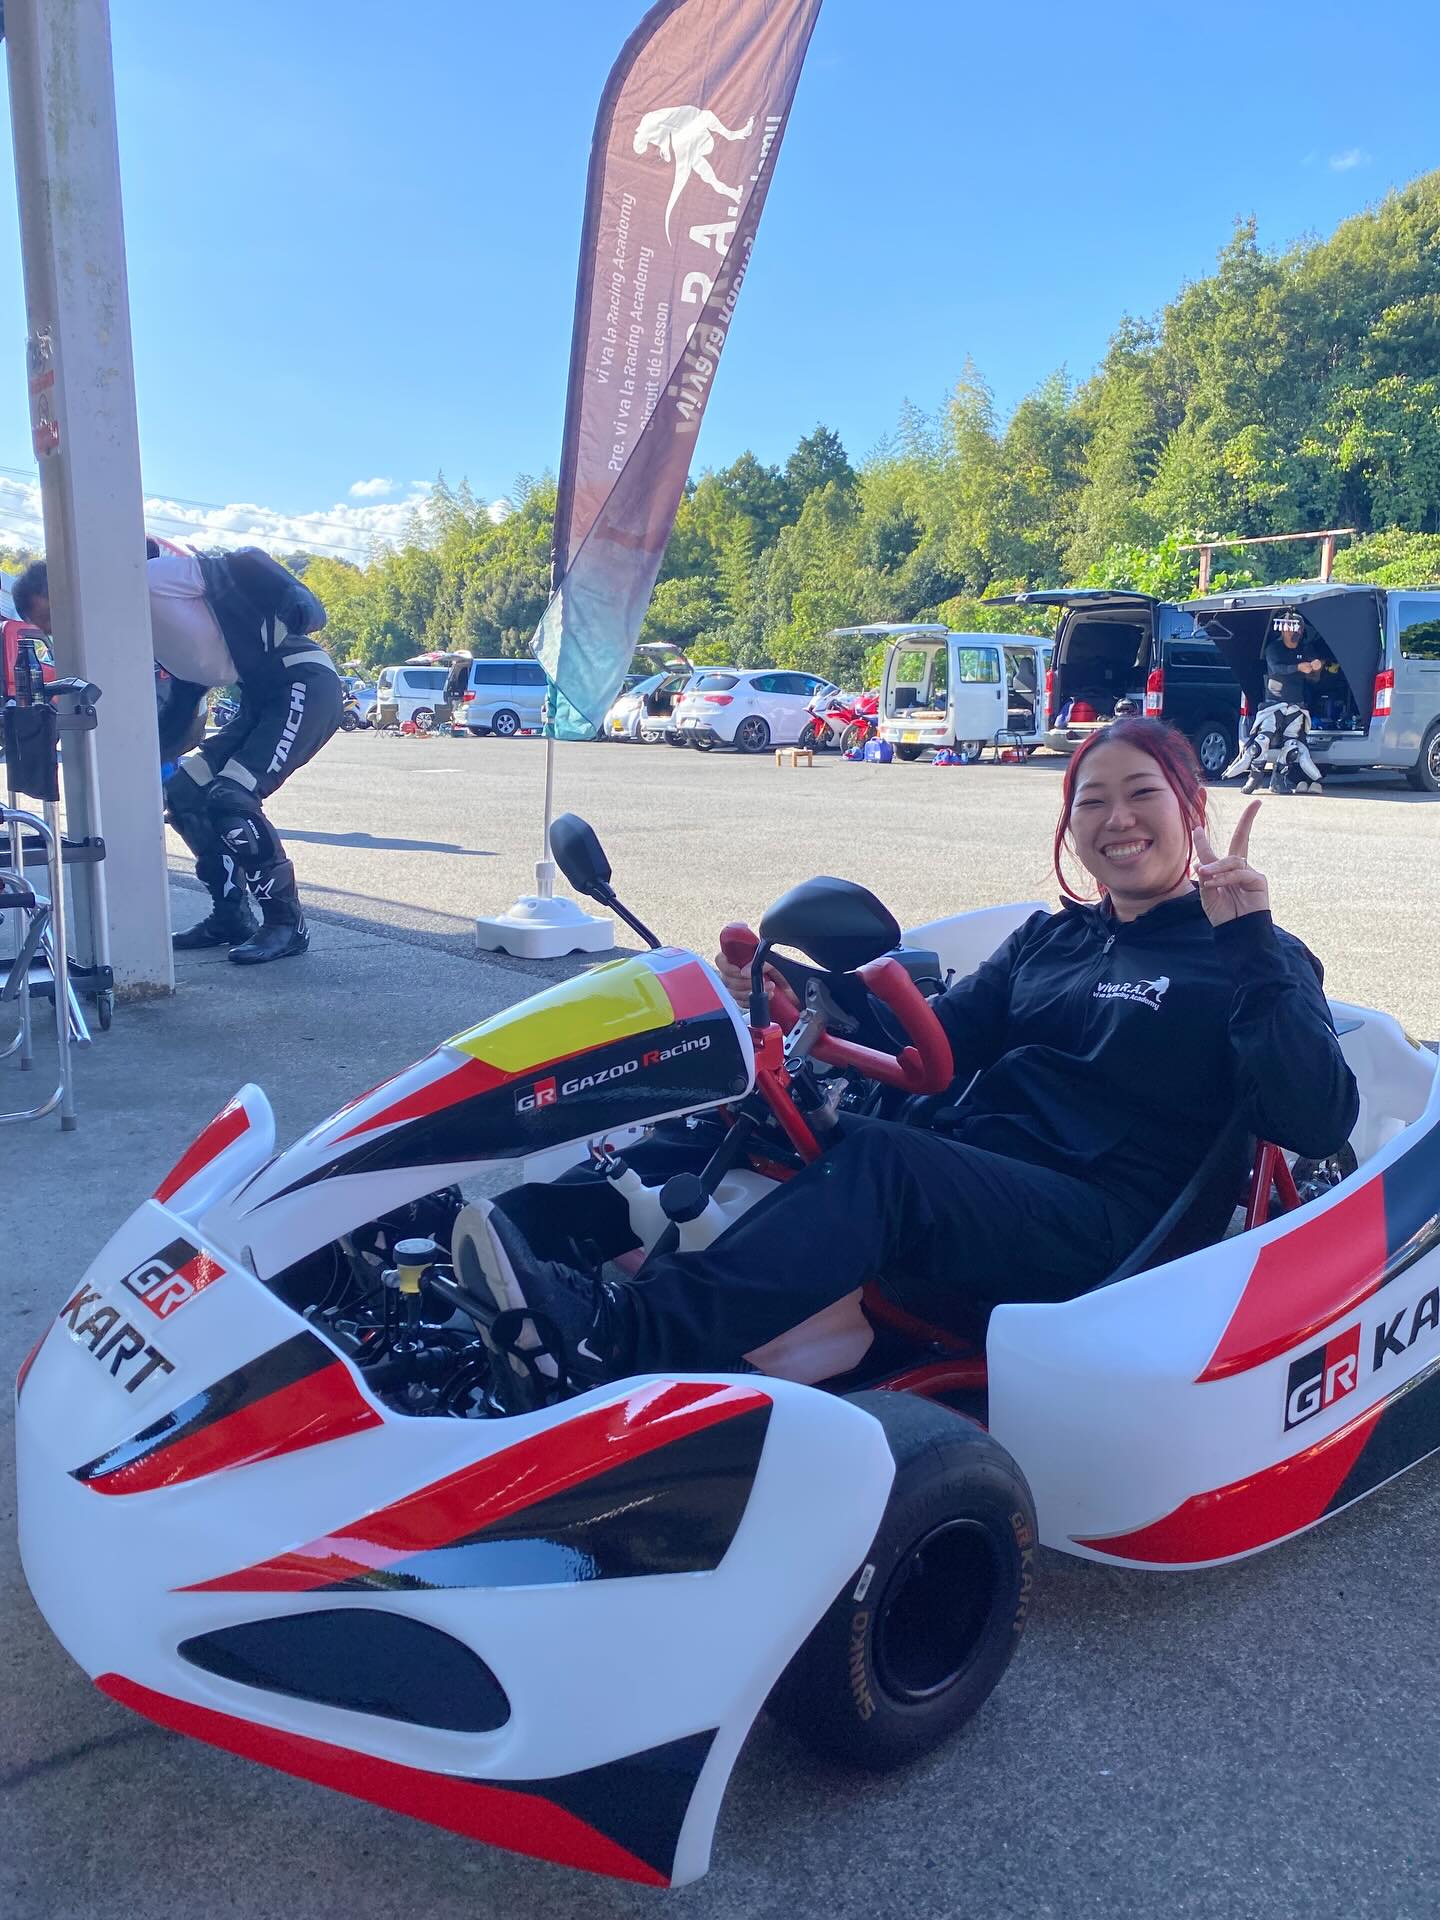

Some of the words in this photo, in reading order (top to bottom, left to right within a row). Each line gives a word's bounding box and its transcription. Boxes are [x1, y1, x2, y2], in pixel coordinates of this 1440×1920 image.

[613, 192, 636, 271] Academy
[606, 272, 626, 325] Racing
[630, 246, 654, 321] Academy
[623, 323, 645, 377] Racing
[650, 302, 669, 355] Lesson
[266, 682, 307, 773] TAICHI
[516, 1088, 555, 1112] GR
[562, 1059, 639, 1096] GAZOO
[642, 1035, 711, 1067] Racing
[127, 1258, 195, 1315] GR
[59, 1283, 176, 1394] KART
[1287, 1353, 1357, 1424] GR
